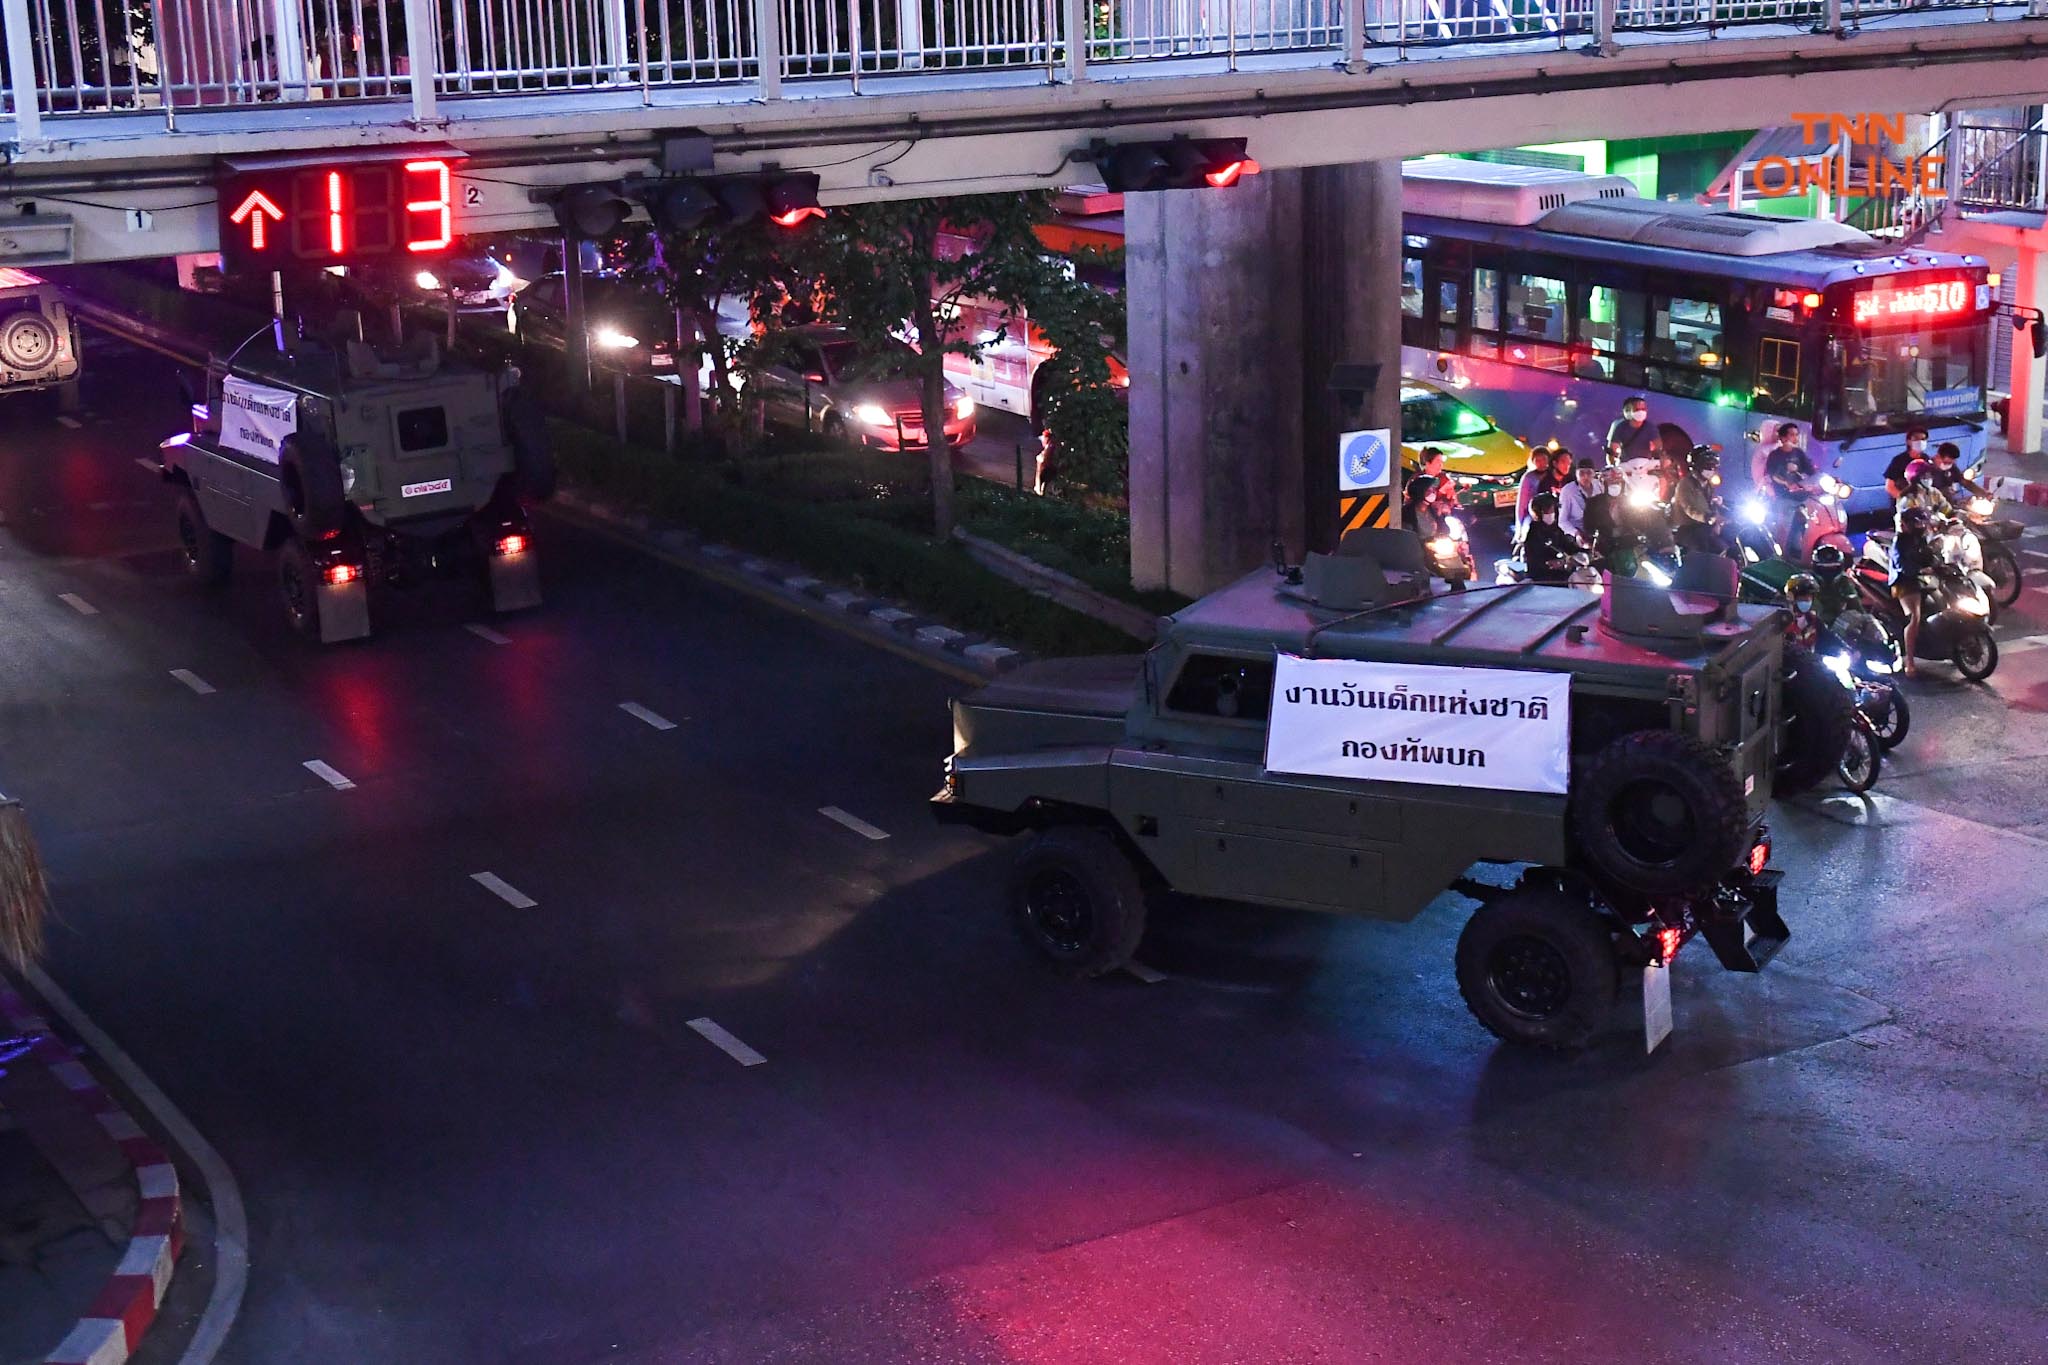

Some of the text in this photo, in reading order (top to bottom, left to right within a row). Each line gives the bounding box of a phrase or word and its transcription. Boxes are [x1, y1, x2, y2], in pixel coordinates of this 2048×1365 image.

[467, 187, 480, 204] 2
[135, 210, 143, 228] 1
[1286, 682, 1549, 720] งานวันเด็กแห่งชาติ
[1342, 737, 1486, 768] กองทัพบก
